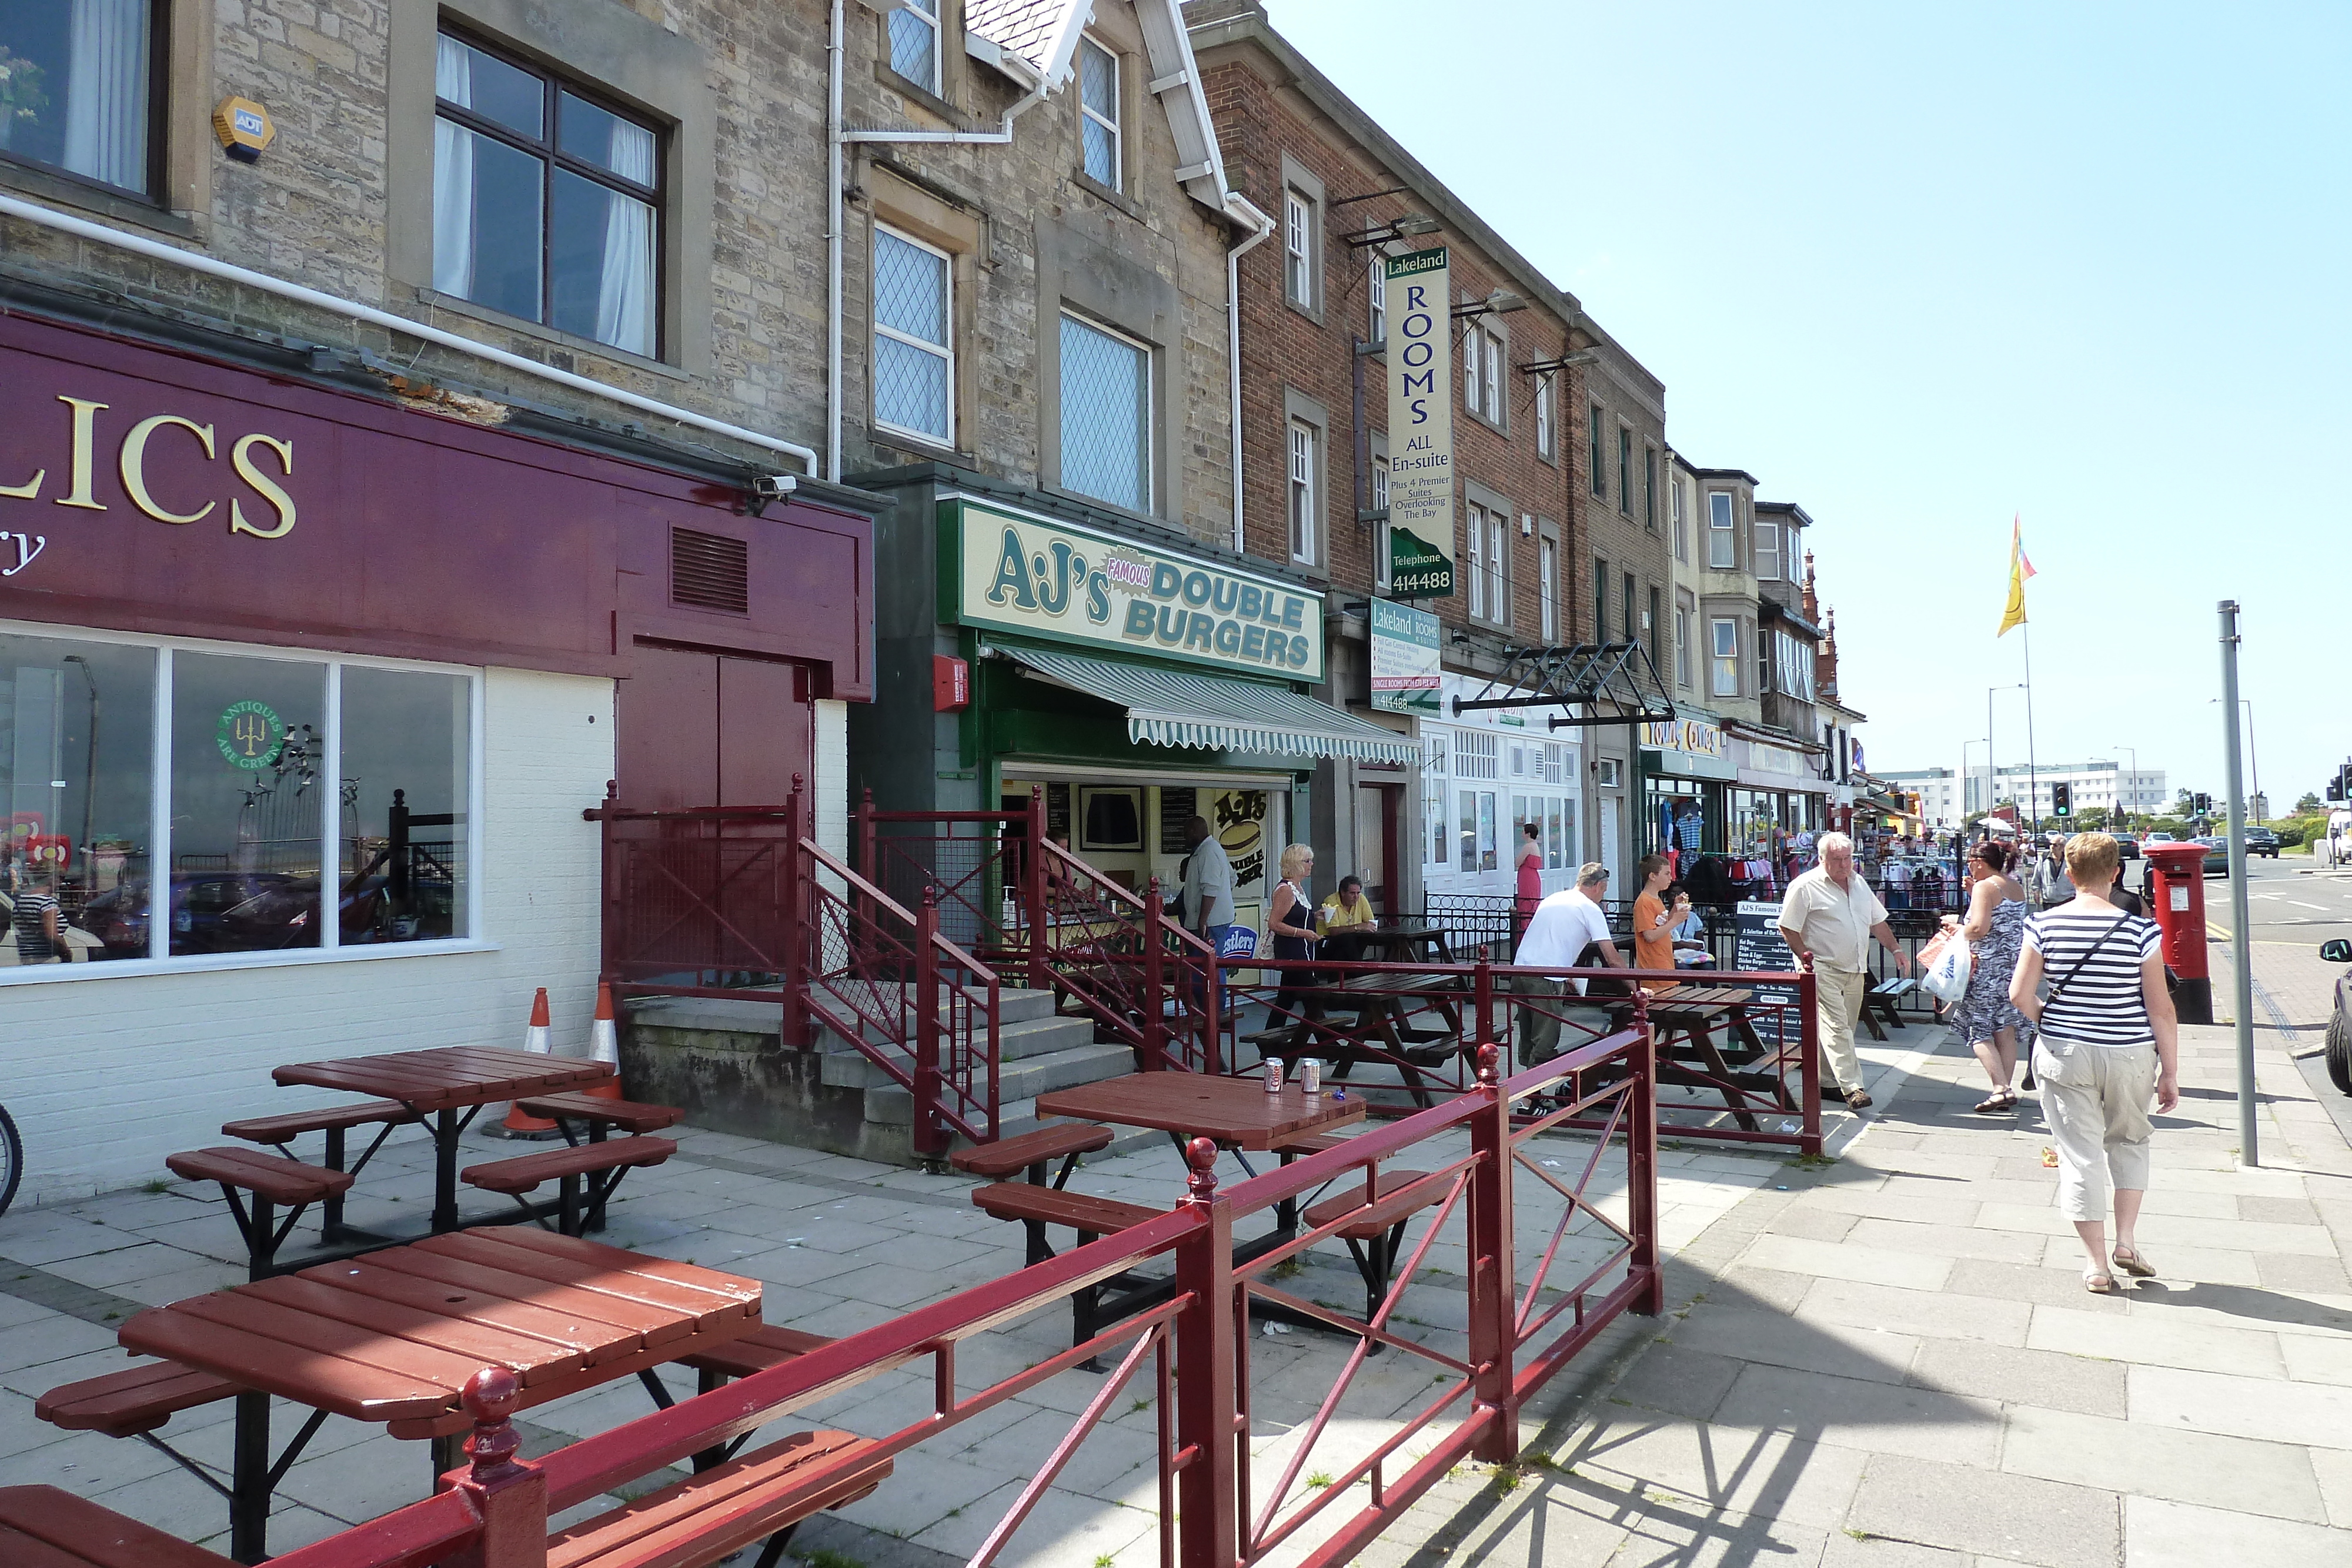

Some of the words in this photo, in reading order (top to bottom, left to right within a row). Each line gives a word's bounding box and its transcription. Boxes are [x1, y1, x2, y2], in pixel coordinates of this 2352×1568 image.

[236, 115, 262, 132] ADT
[1388, 251, 1444, 276] Lakeland
[1401, 285, 1435, 424] ROOMS
[1406, 435, 1433, 452] ALL
[1392, 452, 1448, 472] En-suite
[1391, 480, 1407, 490] Plus
[1410, 479, 1416, 487] 4
[1419, 476, 1450, 487] Premier
[1408, 489, 1432, 498] Suites
[1395, 498, 1446, 510] Overlooking
[1404, 509, 1419, 519] The
[1422, 509, 1436, 519] Bay
[0, 530, 46, 577] y
[1393, 554, 1441, 566] Telephone
[1107, 559, 1151, 588] FAMOUS
[1393, 571, 1450, 591] 414488
[1147, 562, 1305, 633] DOUBLE
[1374, 604, 1411, 636] Lakeland
[1415, 621, 1437, 638] ROOMS
[1122, 599, 1309, 670] BURGERS
[1420, 637, 1437, 647] SUITES
[1373, 679, 1388, 687] SINGLE
[1388, 679, 1403, 687] ROOMS
[1404, 679, 1414, 687] FROM
[1380, 694, 1407, 710] 414488
[222, 701, 282, 732] ANTIQUES
[217, 738, 238, 763] ARE
[240, 744, 280, 768] GREEN
[1271, 1065, 1280, 1088] Coke
